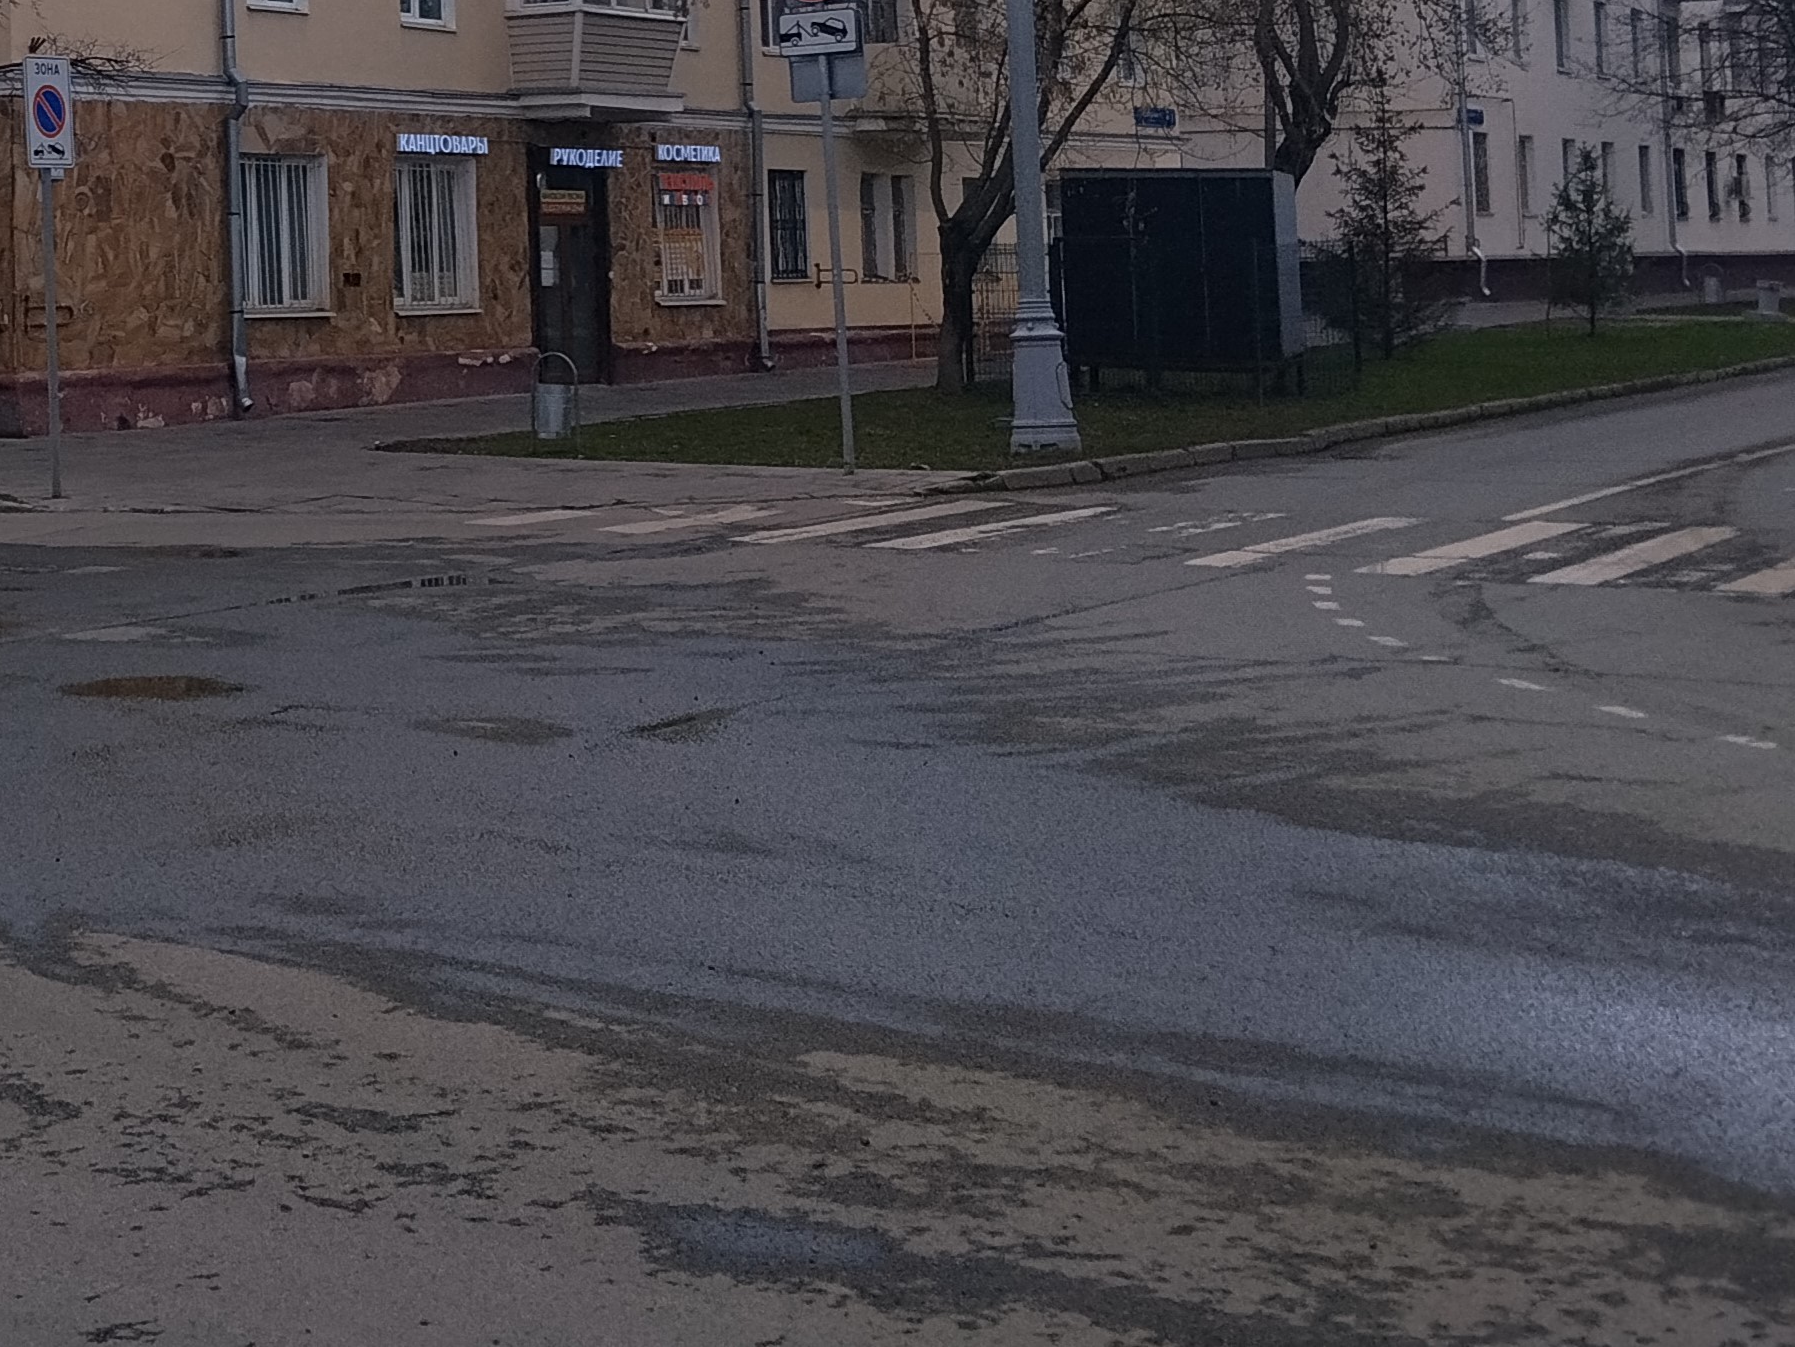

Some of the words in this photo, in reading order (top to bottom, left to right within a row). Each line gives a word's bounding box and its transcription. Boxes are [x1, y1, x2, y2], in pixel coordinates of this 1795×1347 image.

[34, 62, 61, 75] ЗОНА
[399, 134, 489, 155] КАНЦТОВАРЫ
[657, 144, 721, 162] КОСМЕТИКА
[553, 148, 624, 168] РУКОДЕЛИЕ
